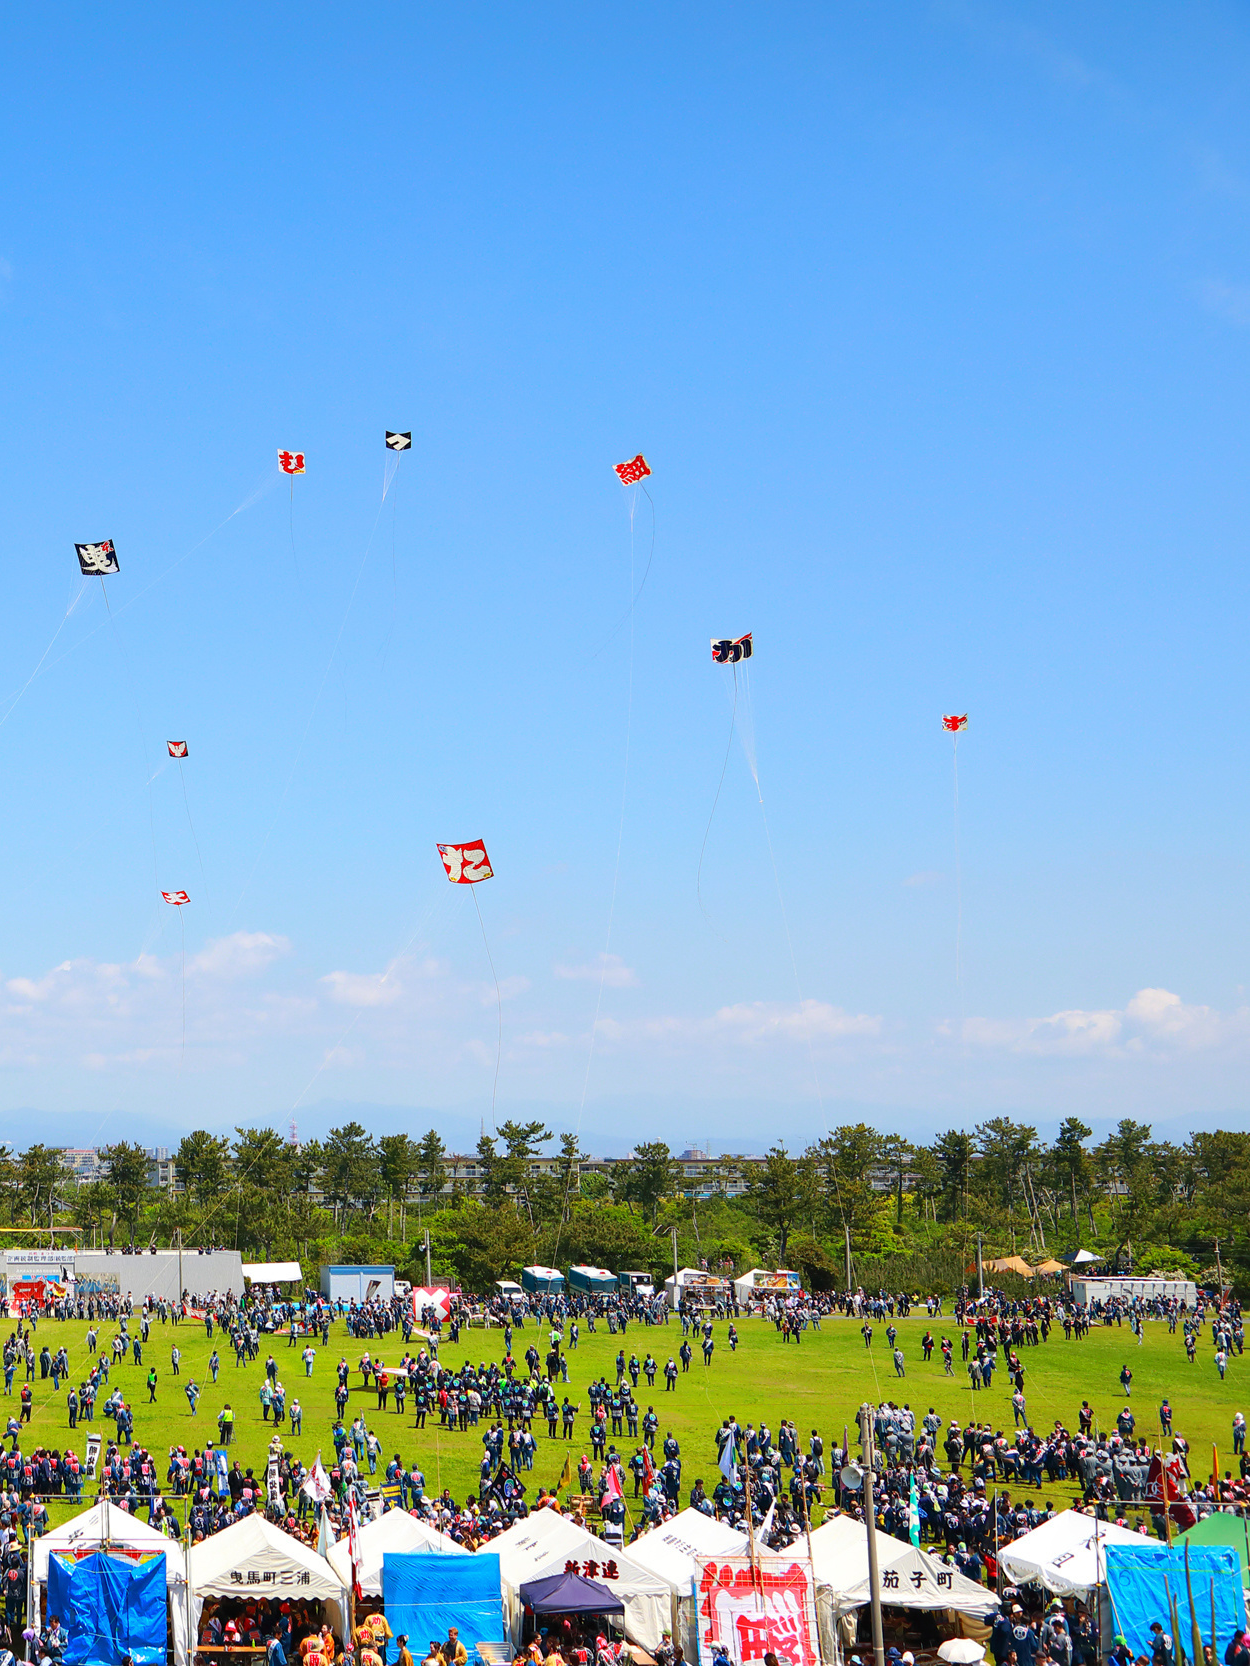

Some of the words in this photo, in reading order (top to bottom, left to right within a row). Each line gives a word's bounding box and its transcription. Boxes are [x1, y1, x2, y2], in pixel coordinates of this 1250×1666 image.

[230, 1571, 310, 1586] 曳馬町三浦
[563, 1559, 620, 1580] 新津連
[882, 1570, 953, 1590] 茄子町
